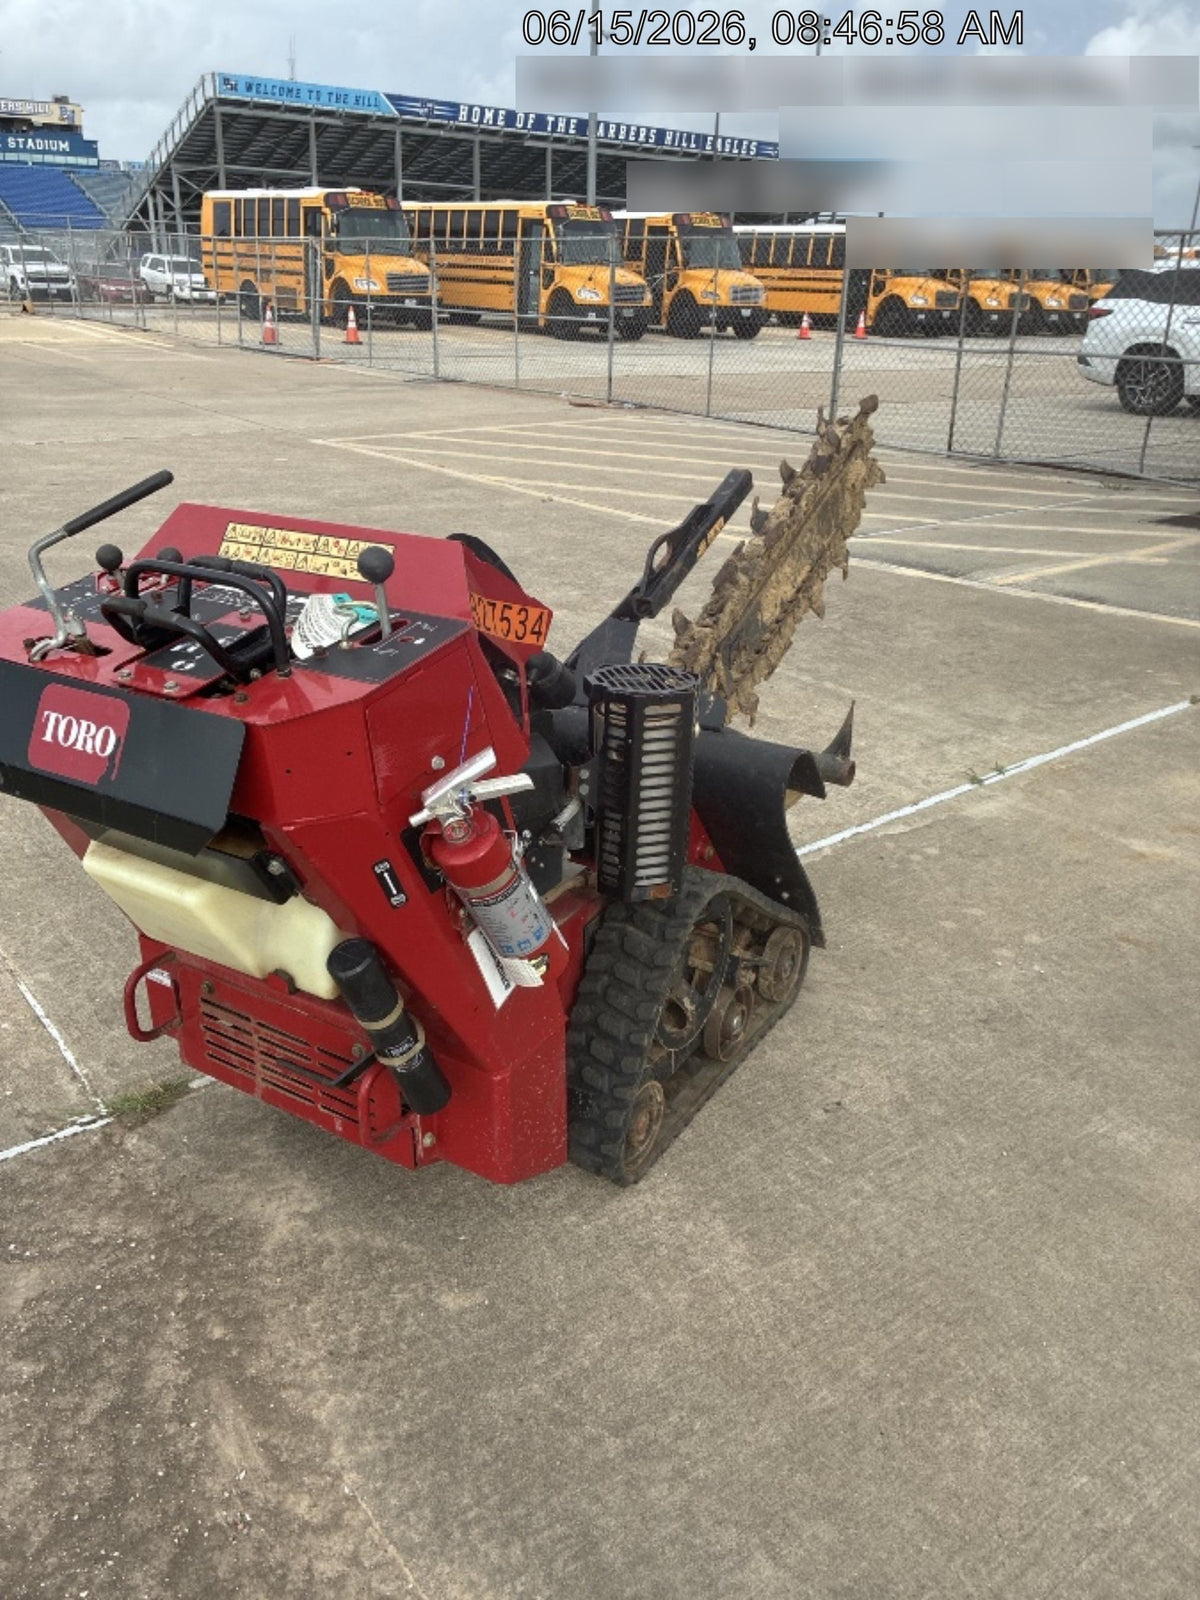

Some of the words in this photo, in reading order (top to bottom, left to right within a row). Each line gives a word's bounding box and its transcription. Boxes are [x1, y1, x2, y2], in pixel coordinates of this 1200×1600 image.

[245, 81, 301, 98] WELCOME
[307, 89, 321, 100] TO
[327, 92, 349, 104] THE
[353, 95, 380, 108] HILL
[7, 136, 70, 152] STADIUM
[458, 104, 505, 126] HOME
[516, 112, 536, 129] OF
[547, 115, 578, 134] THE
[585, 119, 657, 143] ARBERS
[664, 130, 697, 149] HILL
[41, 710, 117, 758] TORO
